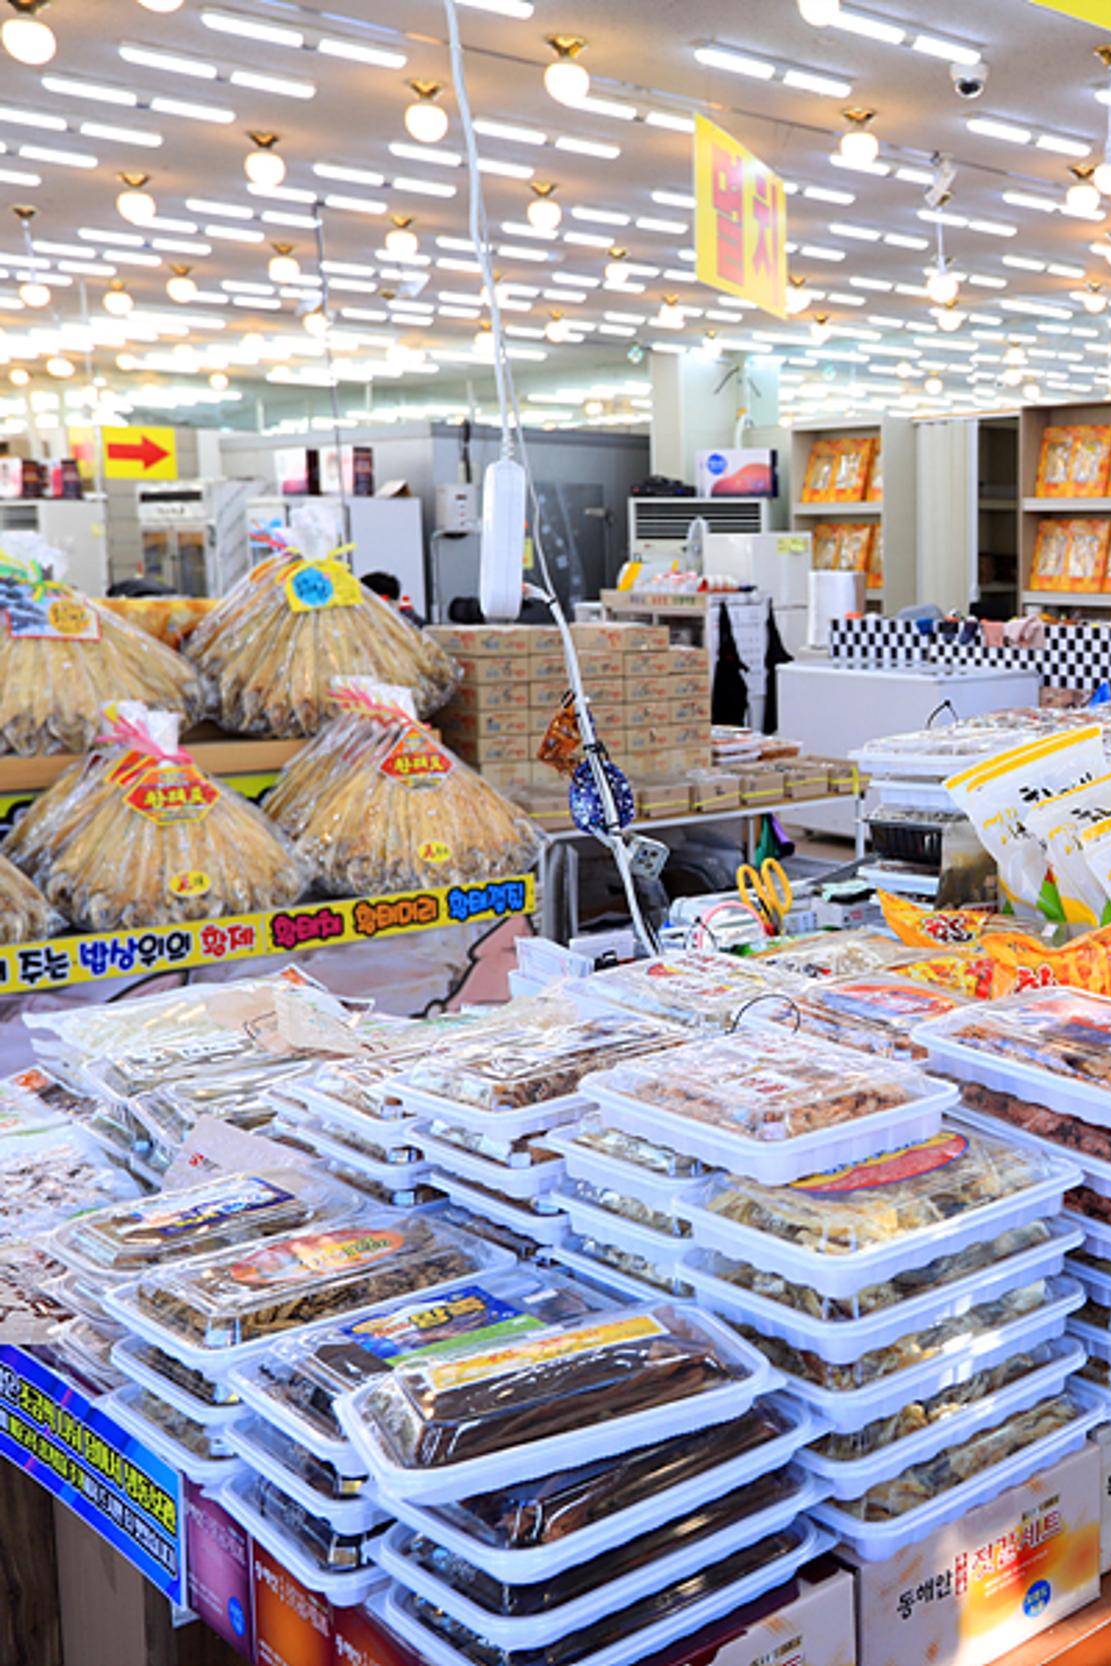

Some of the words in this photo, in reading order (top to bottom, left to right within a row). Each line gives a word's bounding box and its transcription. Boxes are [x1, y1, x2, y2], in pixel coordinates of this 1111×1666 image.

[18, 948, 69, 983] 주는
[79, 932, 191, 976] 밥상위의
[201, 925, 255, 957] 황제
[897, 1568, 952, 1621] 동해안
